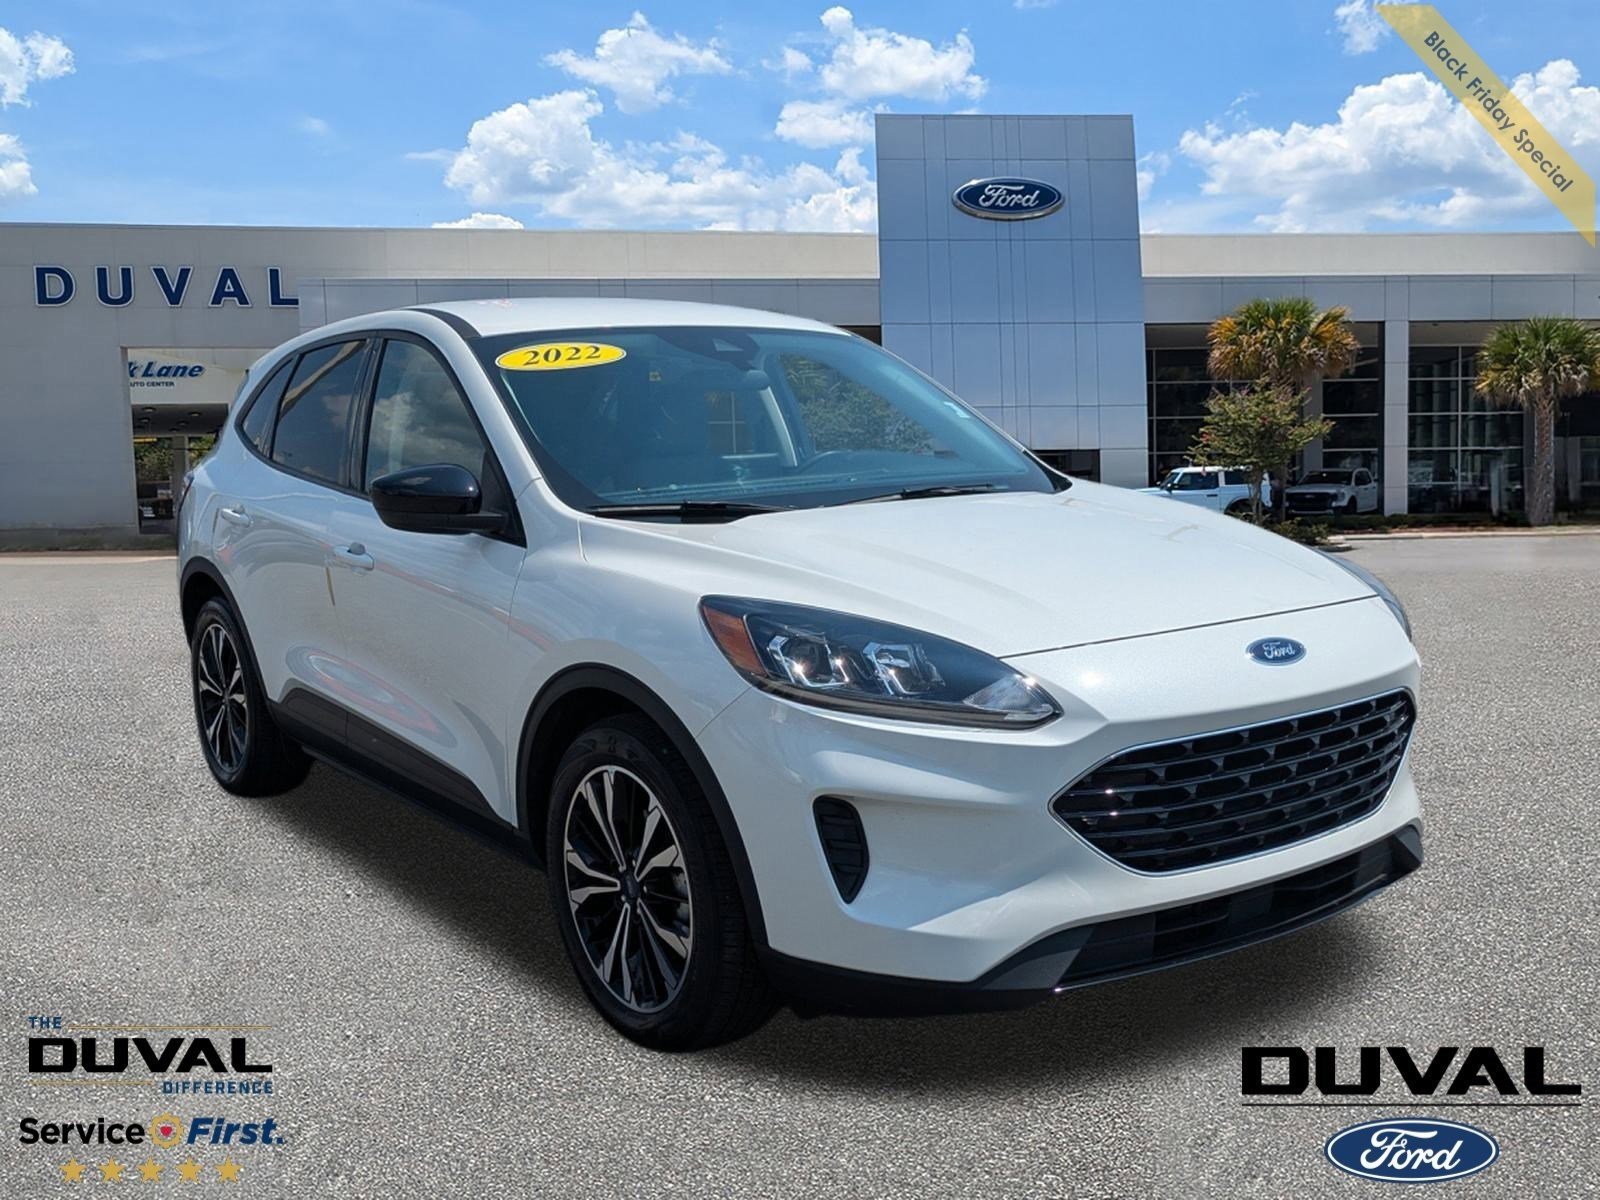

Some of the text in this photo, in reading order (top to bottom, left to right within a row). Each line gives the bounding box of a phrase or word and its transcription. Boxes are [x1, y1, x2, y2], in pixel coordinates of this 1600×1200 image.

[978, 184, 1040, 207] Ford
[34, 265, 299, 307] DUVAL
[523, 345, 601, 366] 2022
[141, 361, 205, 378] Lane
[1262, 641, 1296, 659] Ford
